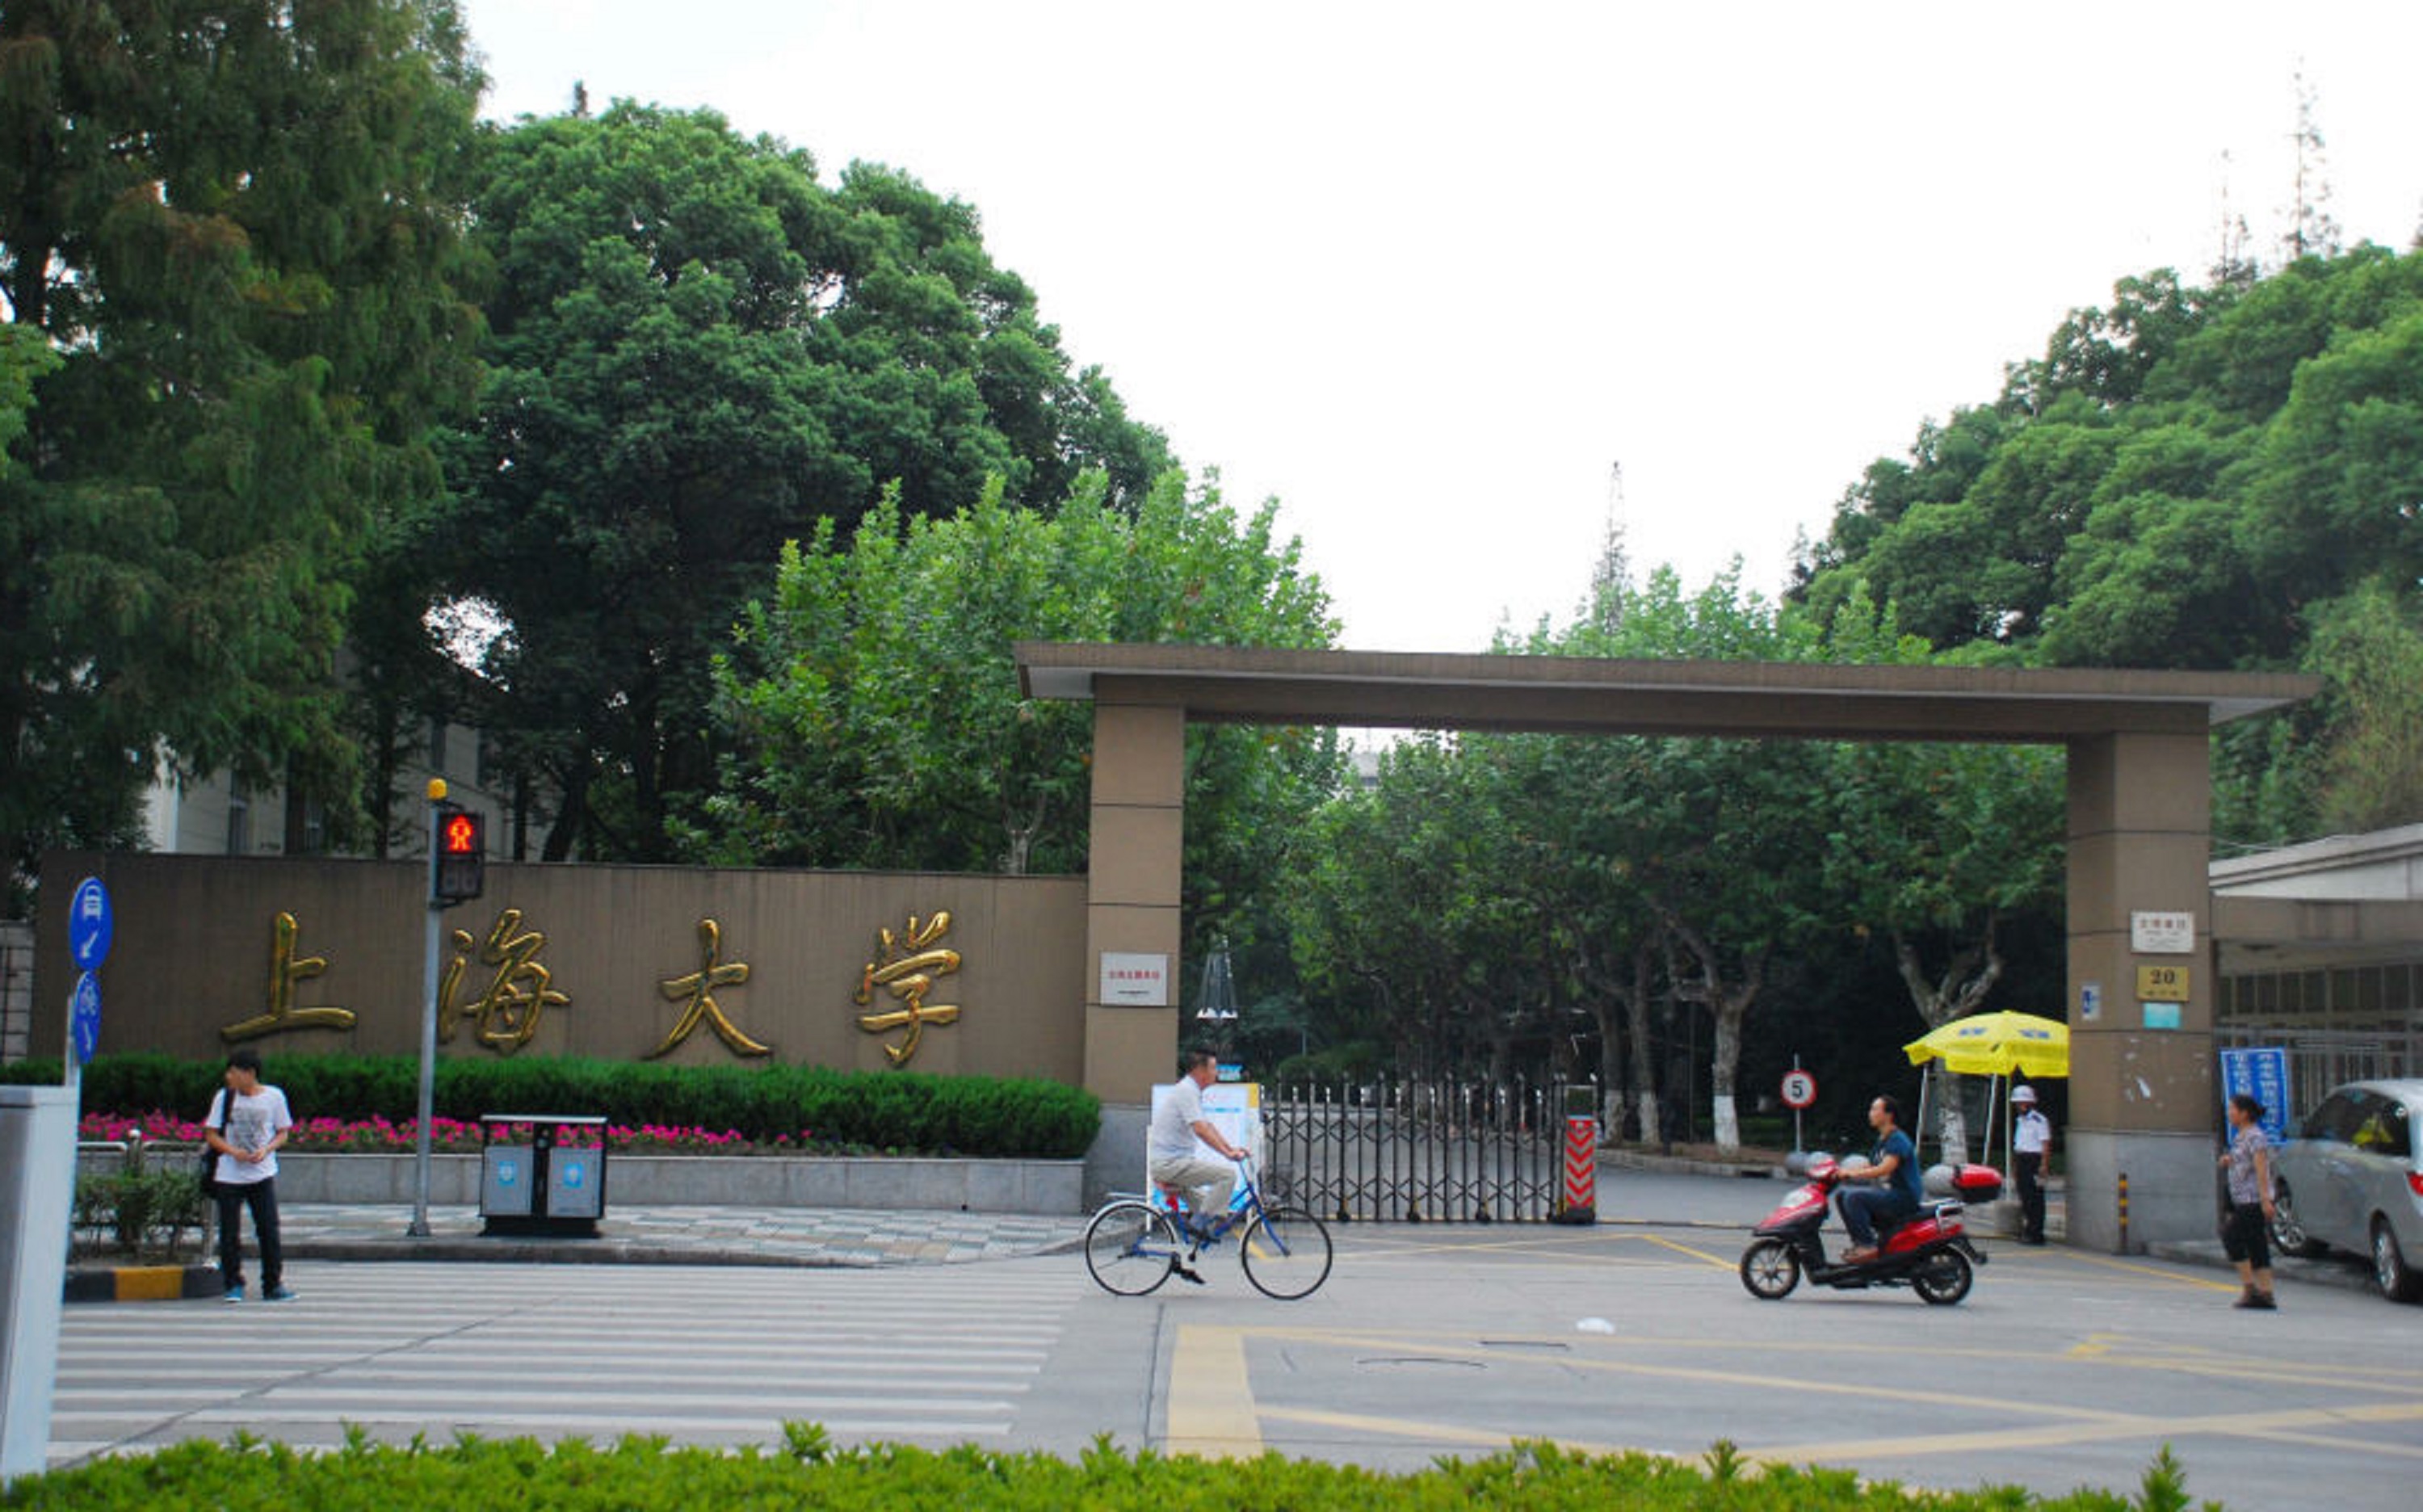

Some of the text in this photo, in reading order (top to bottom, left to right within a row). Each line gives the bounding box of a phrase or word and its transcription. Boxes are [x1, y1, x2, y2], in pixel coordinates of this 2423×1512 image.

[2149, 968, 2176, 985] 20
[220, 908, 962, 1067] 上海大学
[1791, 1079, 1804, 1098] 5
